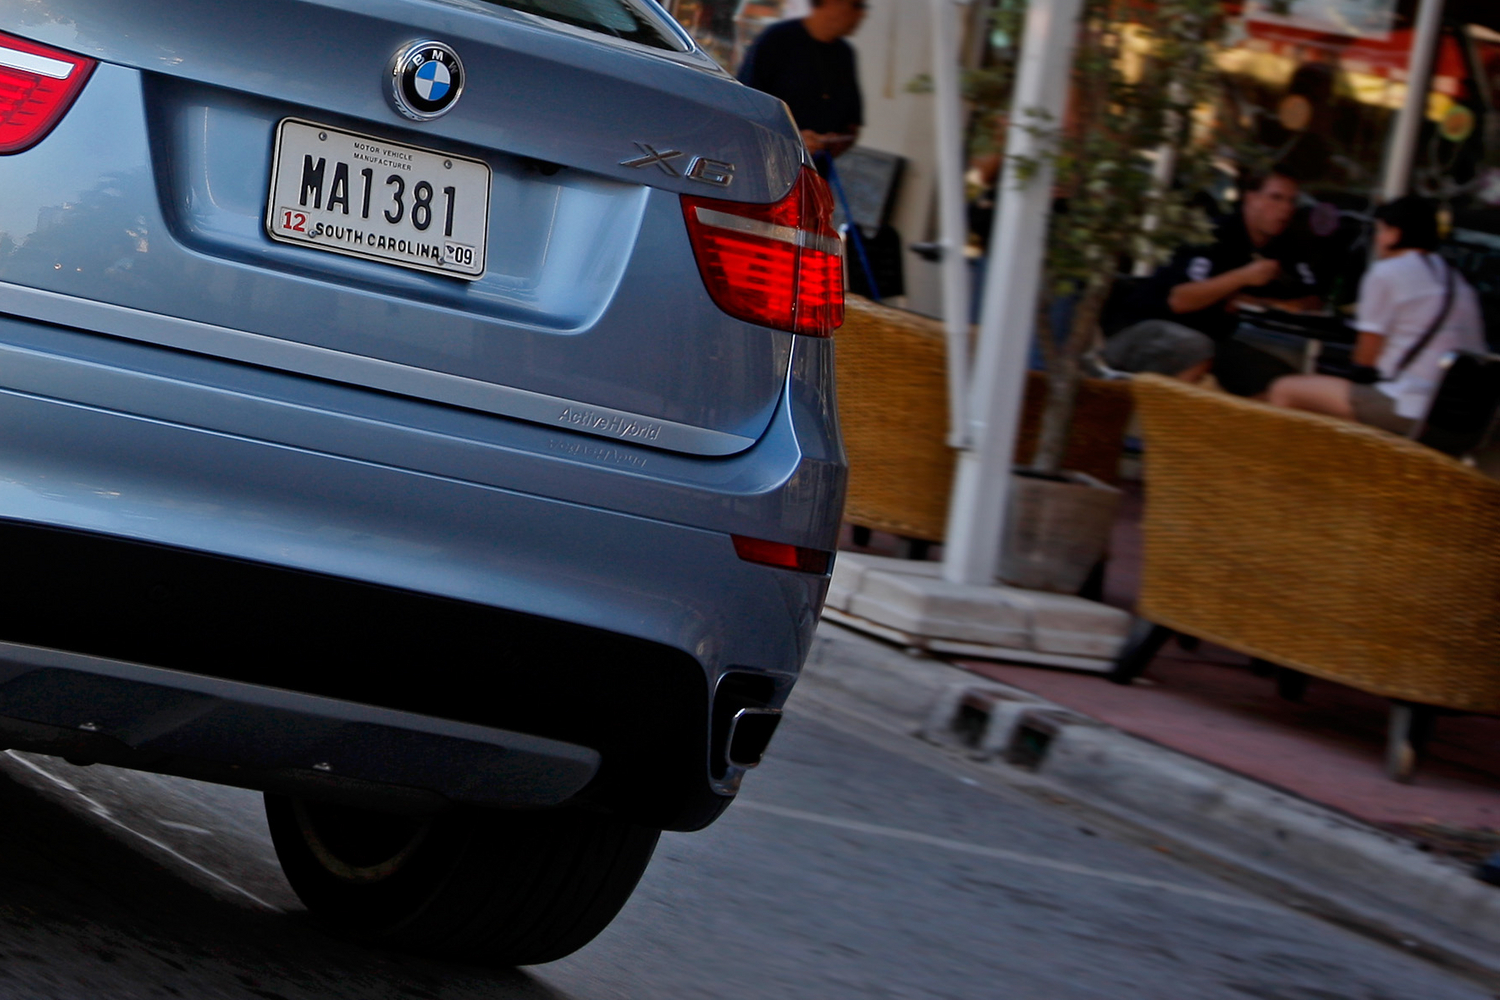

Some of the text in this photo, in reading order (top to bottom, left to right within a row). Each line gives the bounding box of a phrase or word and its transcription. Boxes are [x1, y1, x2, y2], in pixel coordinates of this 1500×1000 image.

[412, 49, 459, 74] BMW
[353, 152, 412, 171] MANUFACTURER
[354, 142, 413, 161] MOTOR VEHICLE
[618, 141, 736, 187] X6
[299, 154, 456, 237] MA1381
[282, 211, 307, 232] 12
[314, 222, 440, 259] SOUTH CAROLINA
[455, 246, 472, 265] 09
[558, 407, 662, 441] ActiveHybrid
